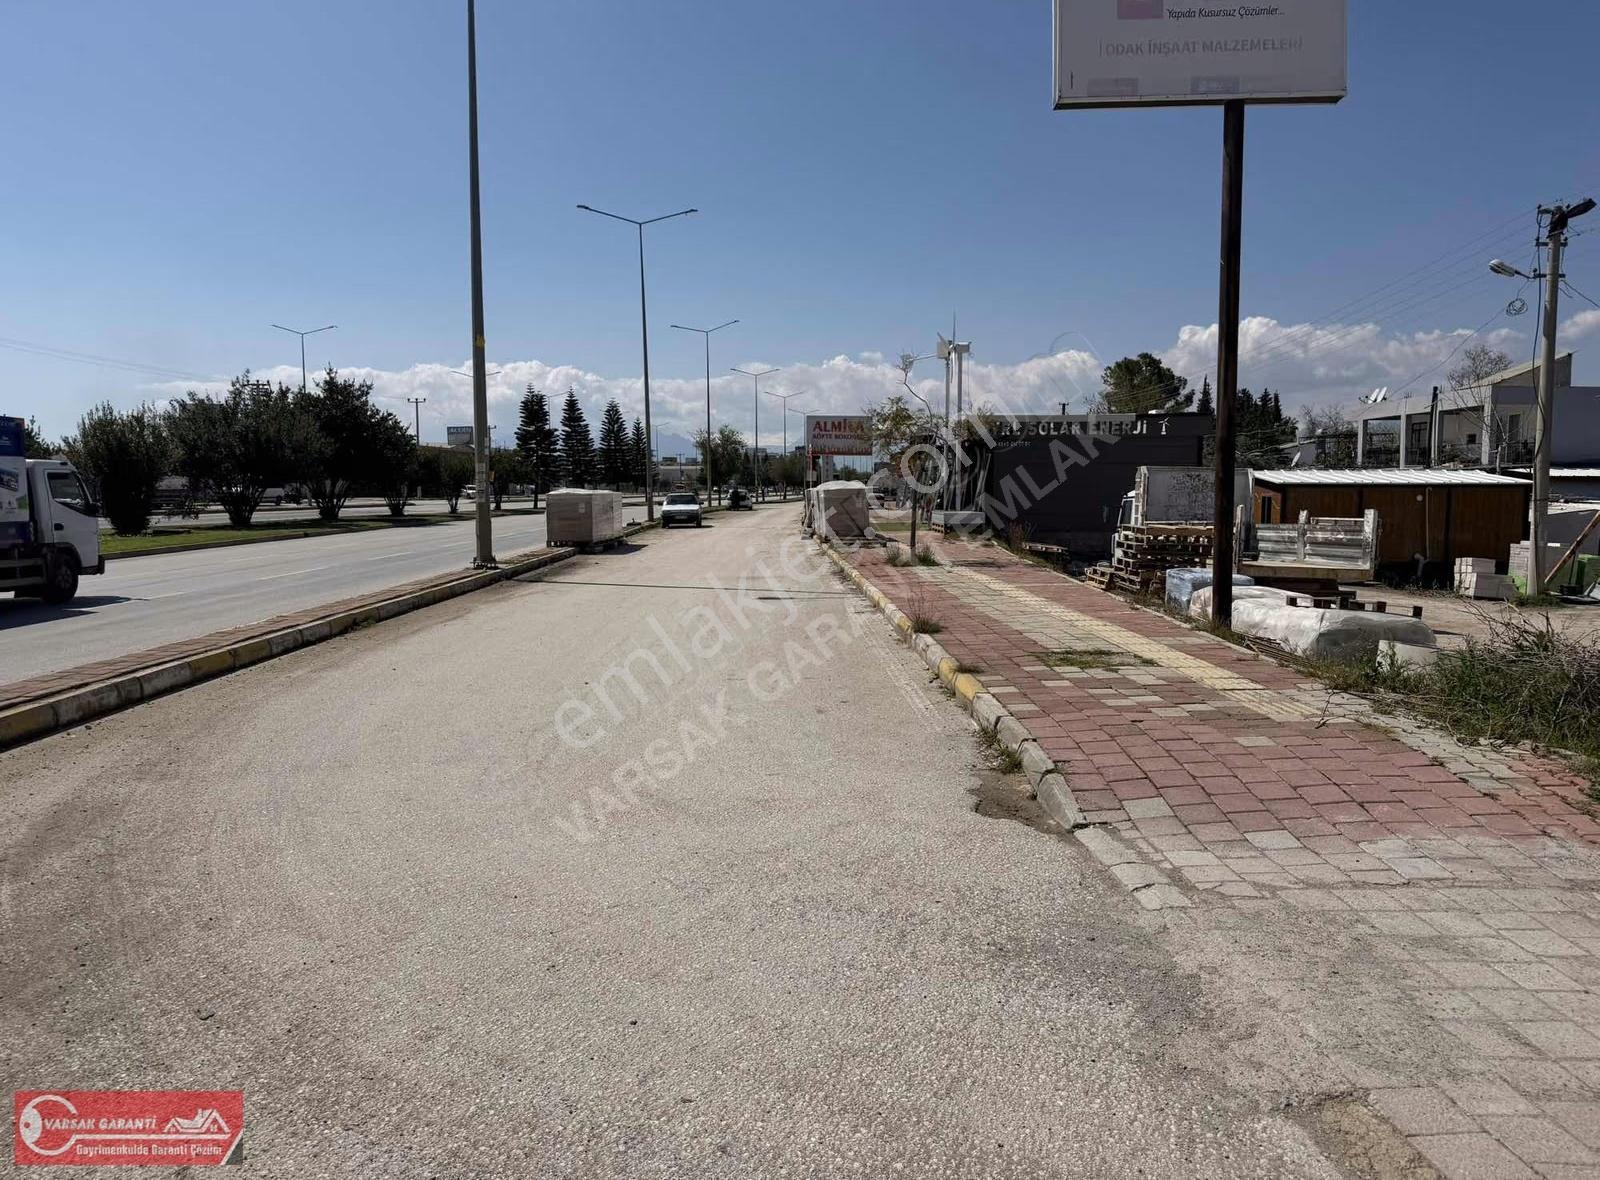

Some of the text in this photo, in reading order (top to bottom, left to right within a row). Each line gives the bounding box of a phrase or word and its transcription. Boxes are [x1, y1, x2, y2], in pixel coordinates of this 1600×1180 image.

[1167, 8, 1196, 20] Yapıda
[1199, 7, 1236, 17] Kusursuz
[1105, 43, 1143, 56] ODAK
[1148, 39, 1197, 57] İNŞAAT
[1027, 421, 1082, 436] SOLAR
